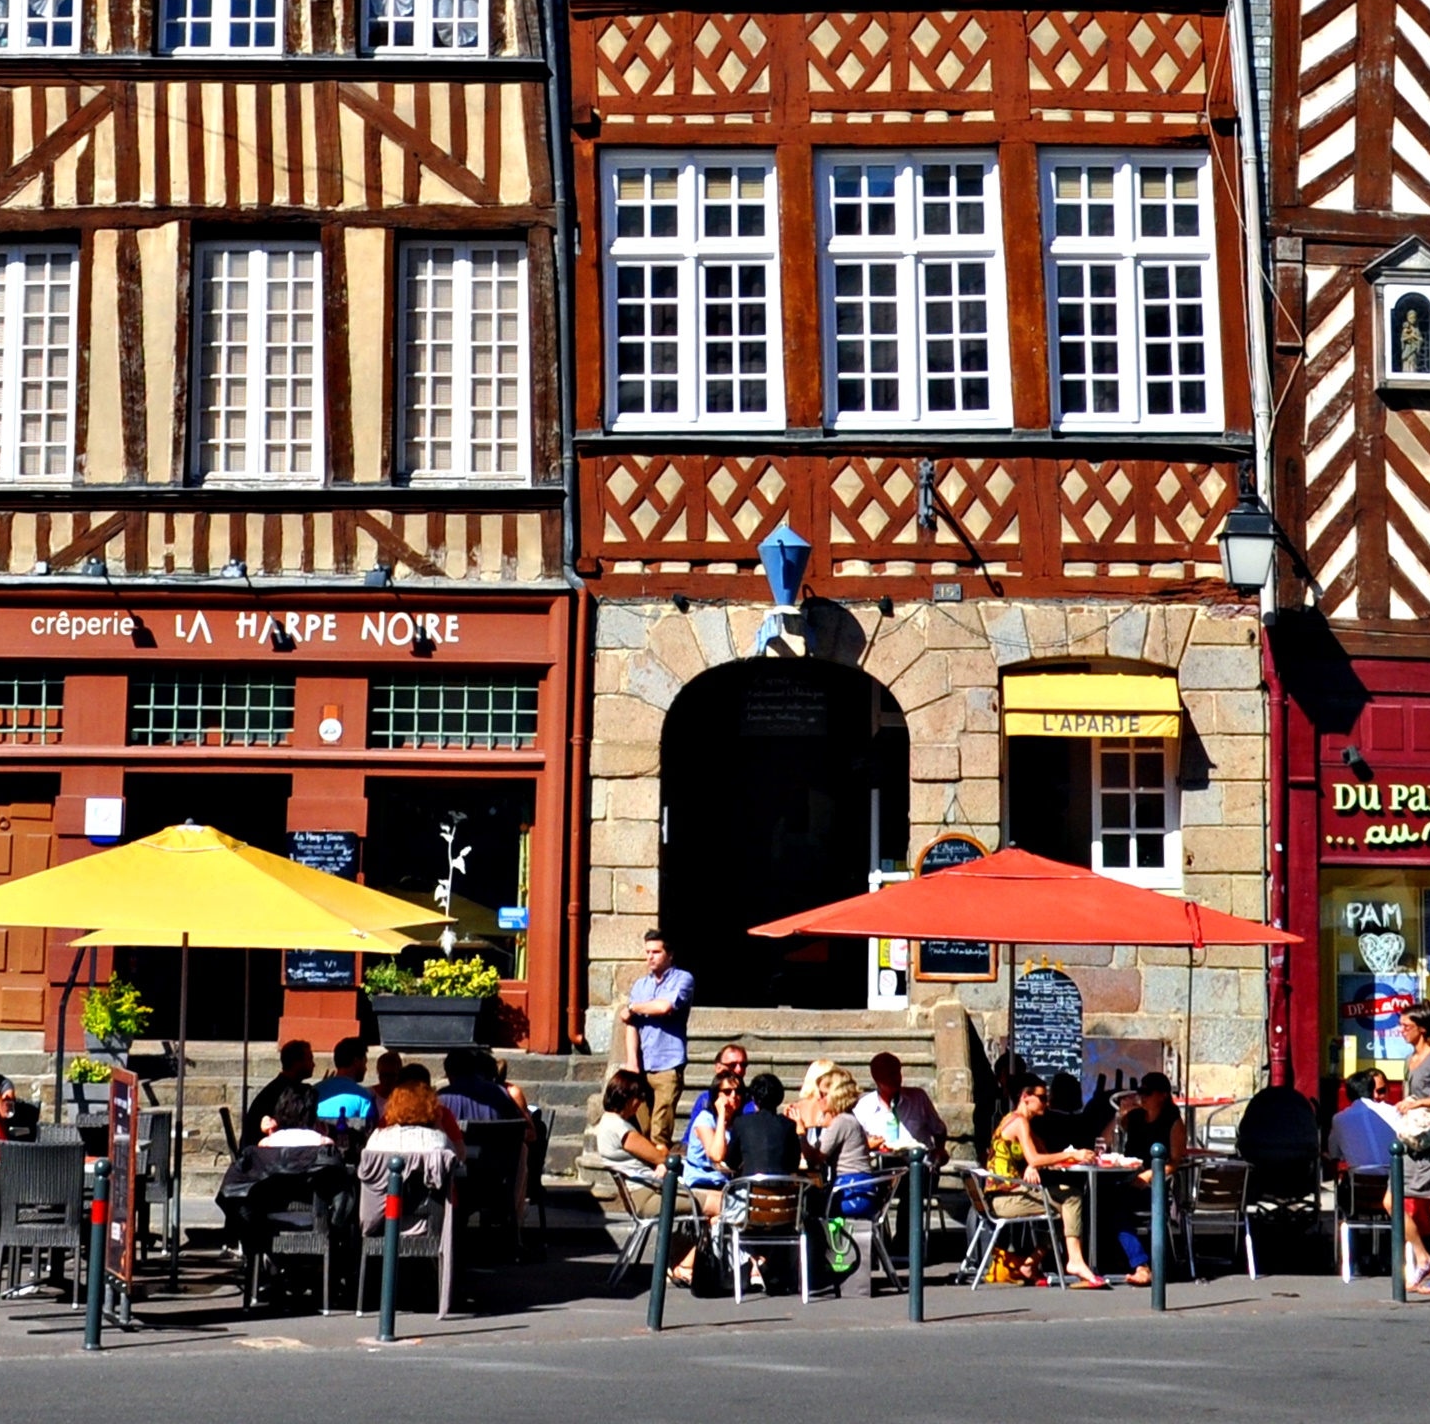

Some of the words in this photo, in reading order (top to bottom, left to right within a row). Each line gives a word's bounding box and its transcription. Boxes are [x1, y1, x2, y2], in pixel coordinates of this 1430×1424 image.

[940, 586, 954, 597] 15
[31, 611, 135, 640] crêperie
[175, 610, 212, 644] LA
[235, 611, 337, 644] HARPE
[361, 611, 459, 646] NOIRE
[1346, 903, 1402, 930] PAM
